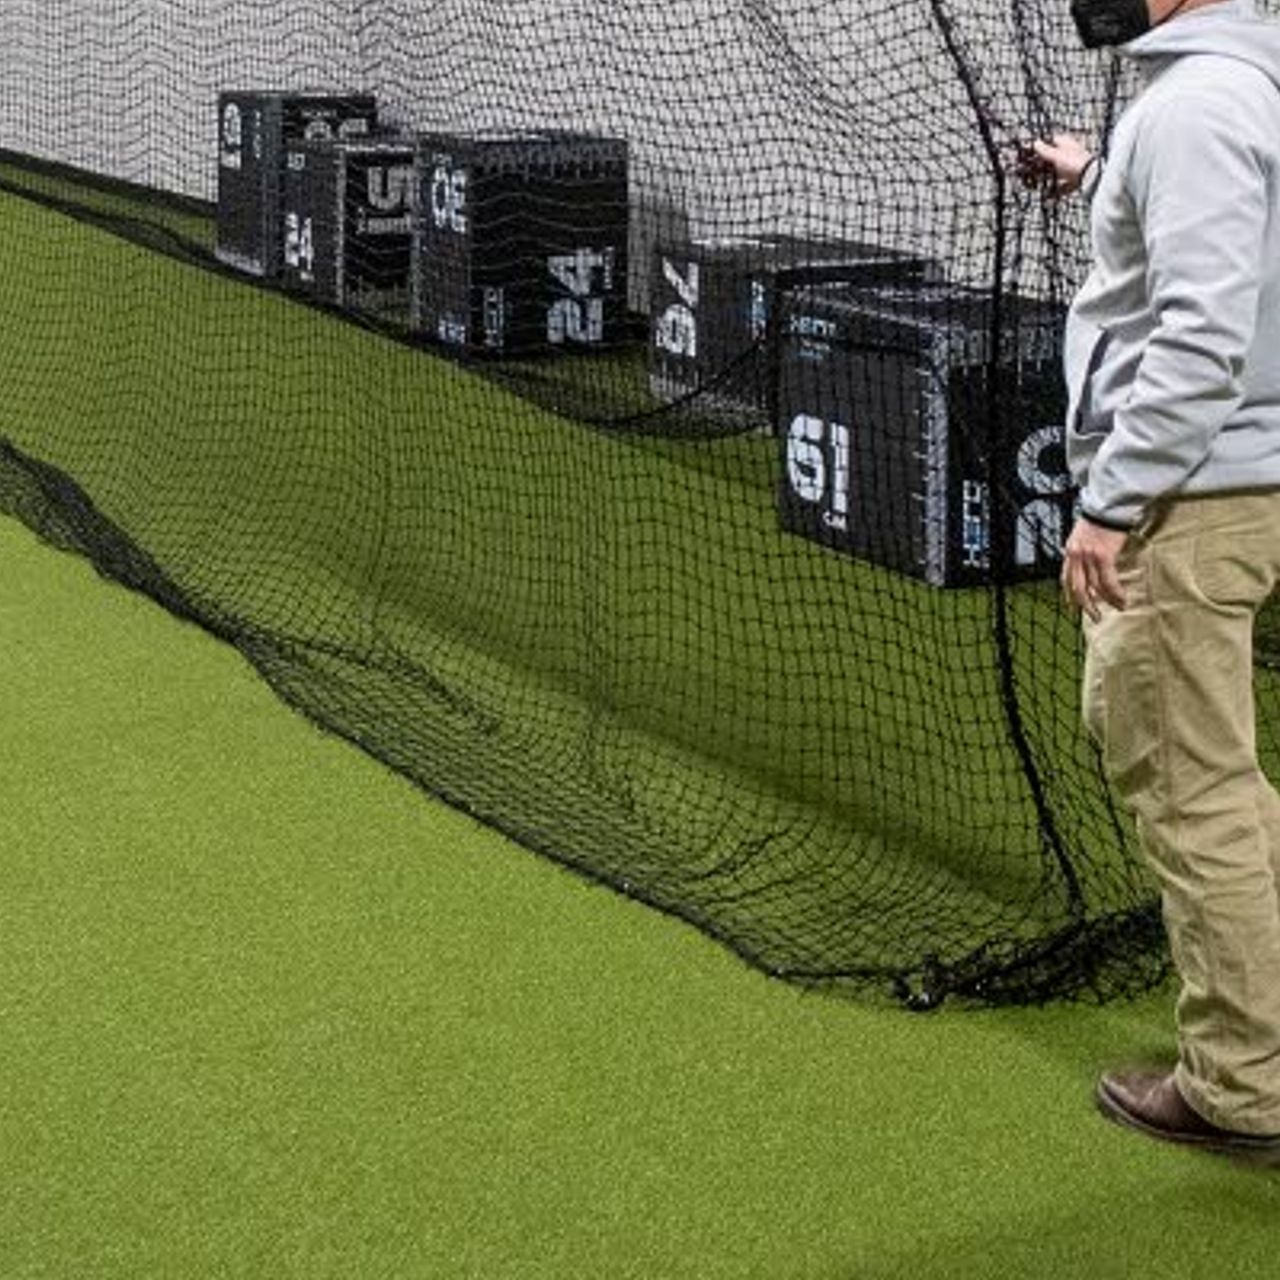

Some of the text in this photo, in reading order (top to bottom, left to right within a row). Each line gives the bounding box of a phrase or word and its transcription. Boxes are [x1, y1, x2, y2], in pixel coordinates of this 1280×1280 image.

[547, 248, 603, 344] 24
[662, 257, 699, 357] 76
[787, 413, 850, 513] 61
